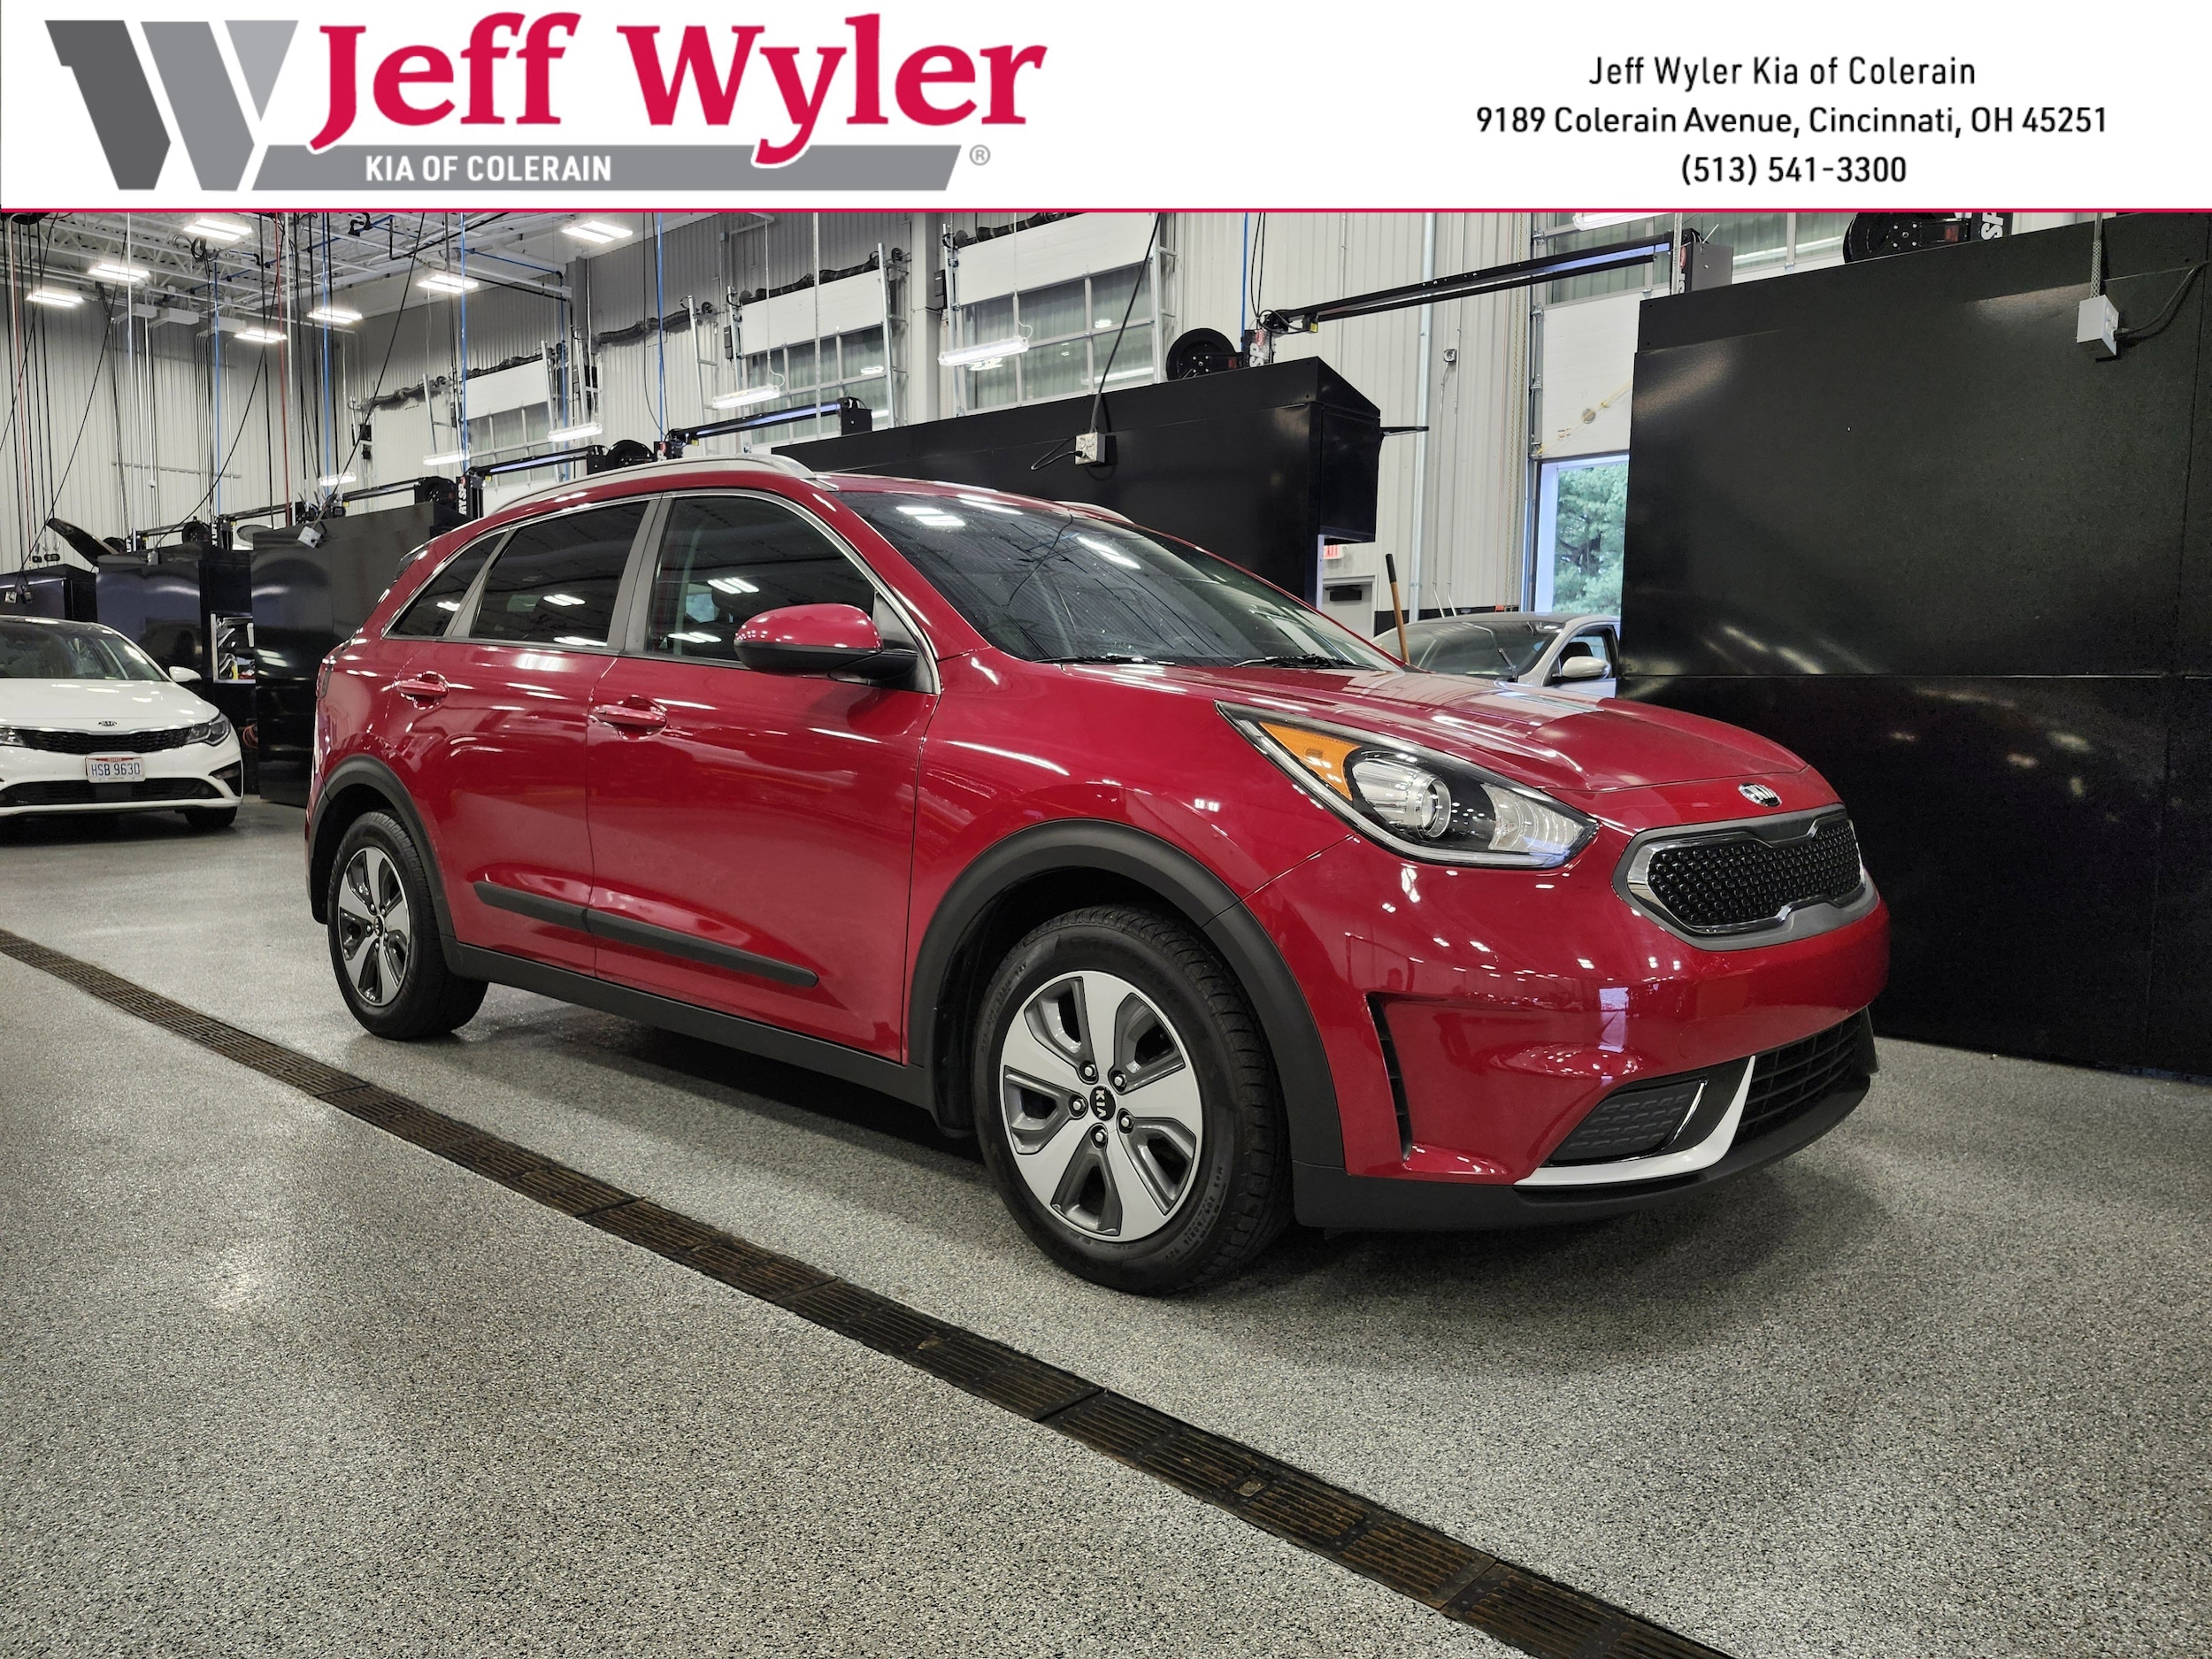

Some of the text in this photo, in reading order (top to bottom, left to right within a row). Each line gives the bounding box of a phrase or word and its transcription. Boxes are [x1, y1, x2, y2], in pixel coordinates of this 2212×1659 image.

[1323, 544, 1338, 557] XIT
[91, 763, 141, 777] HSB 9630
[1095, 1089, 1107, 1118] KIA
